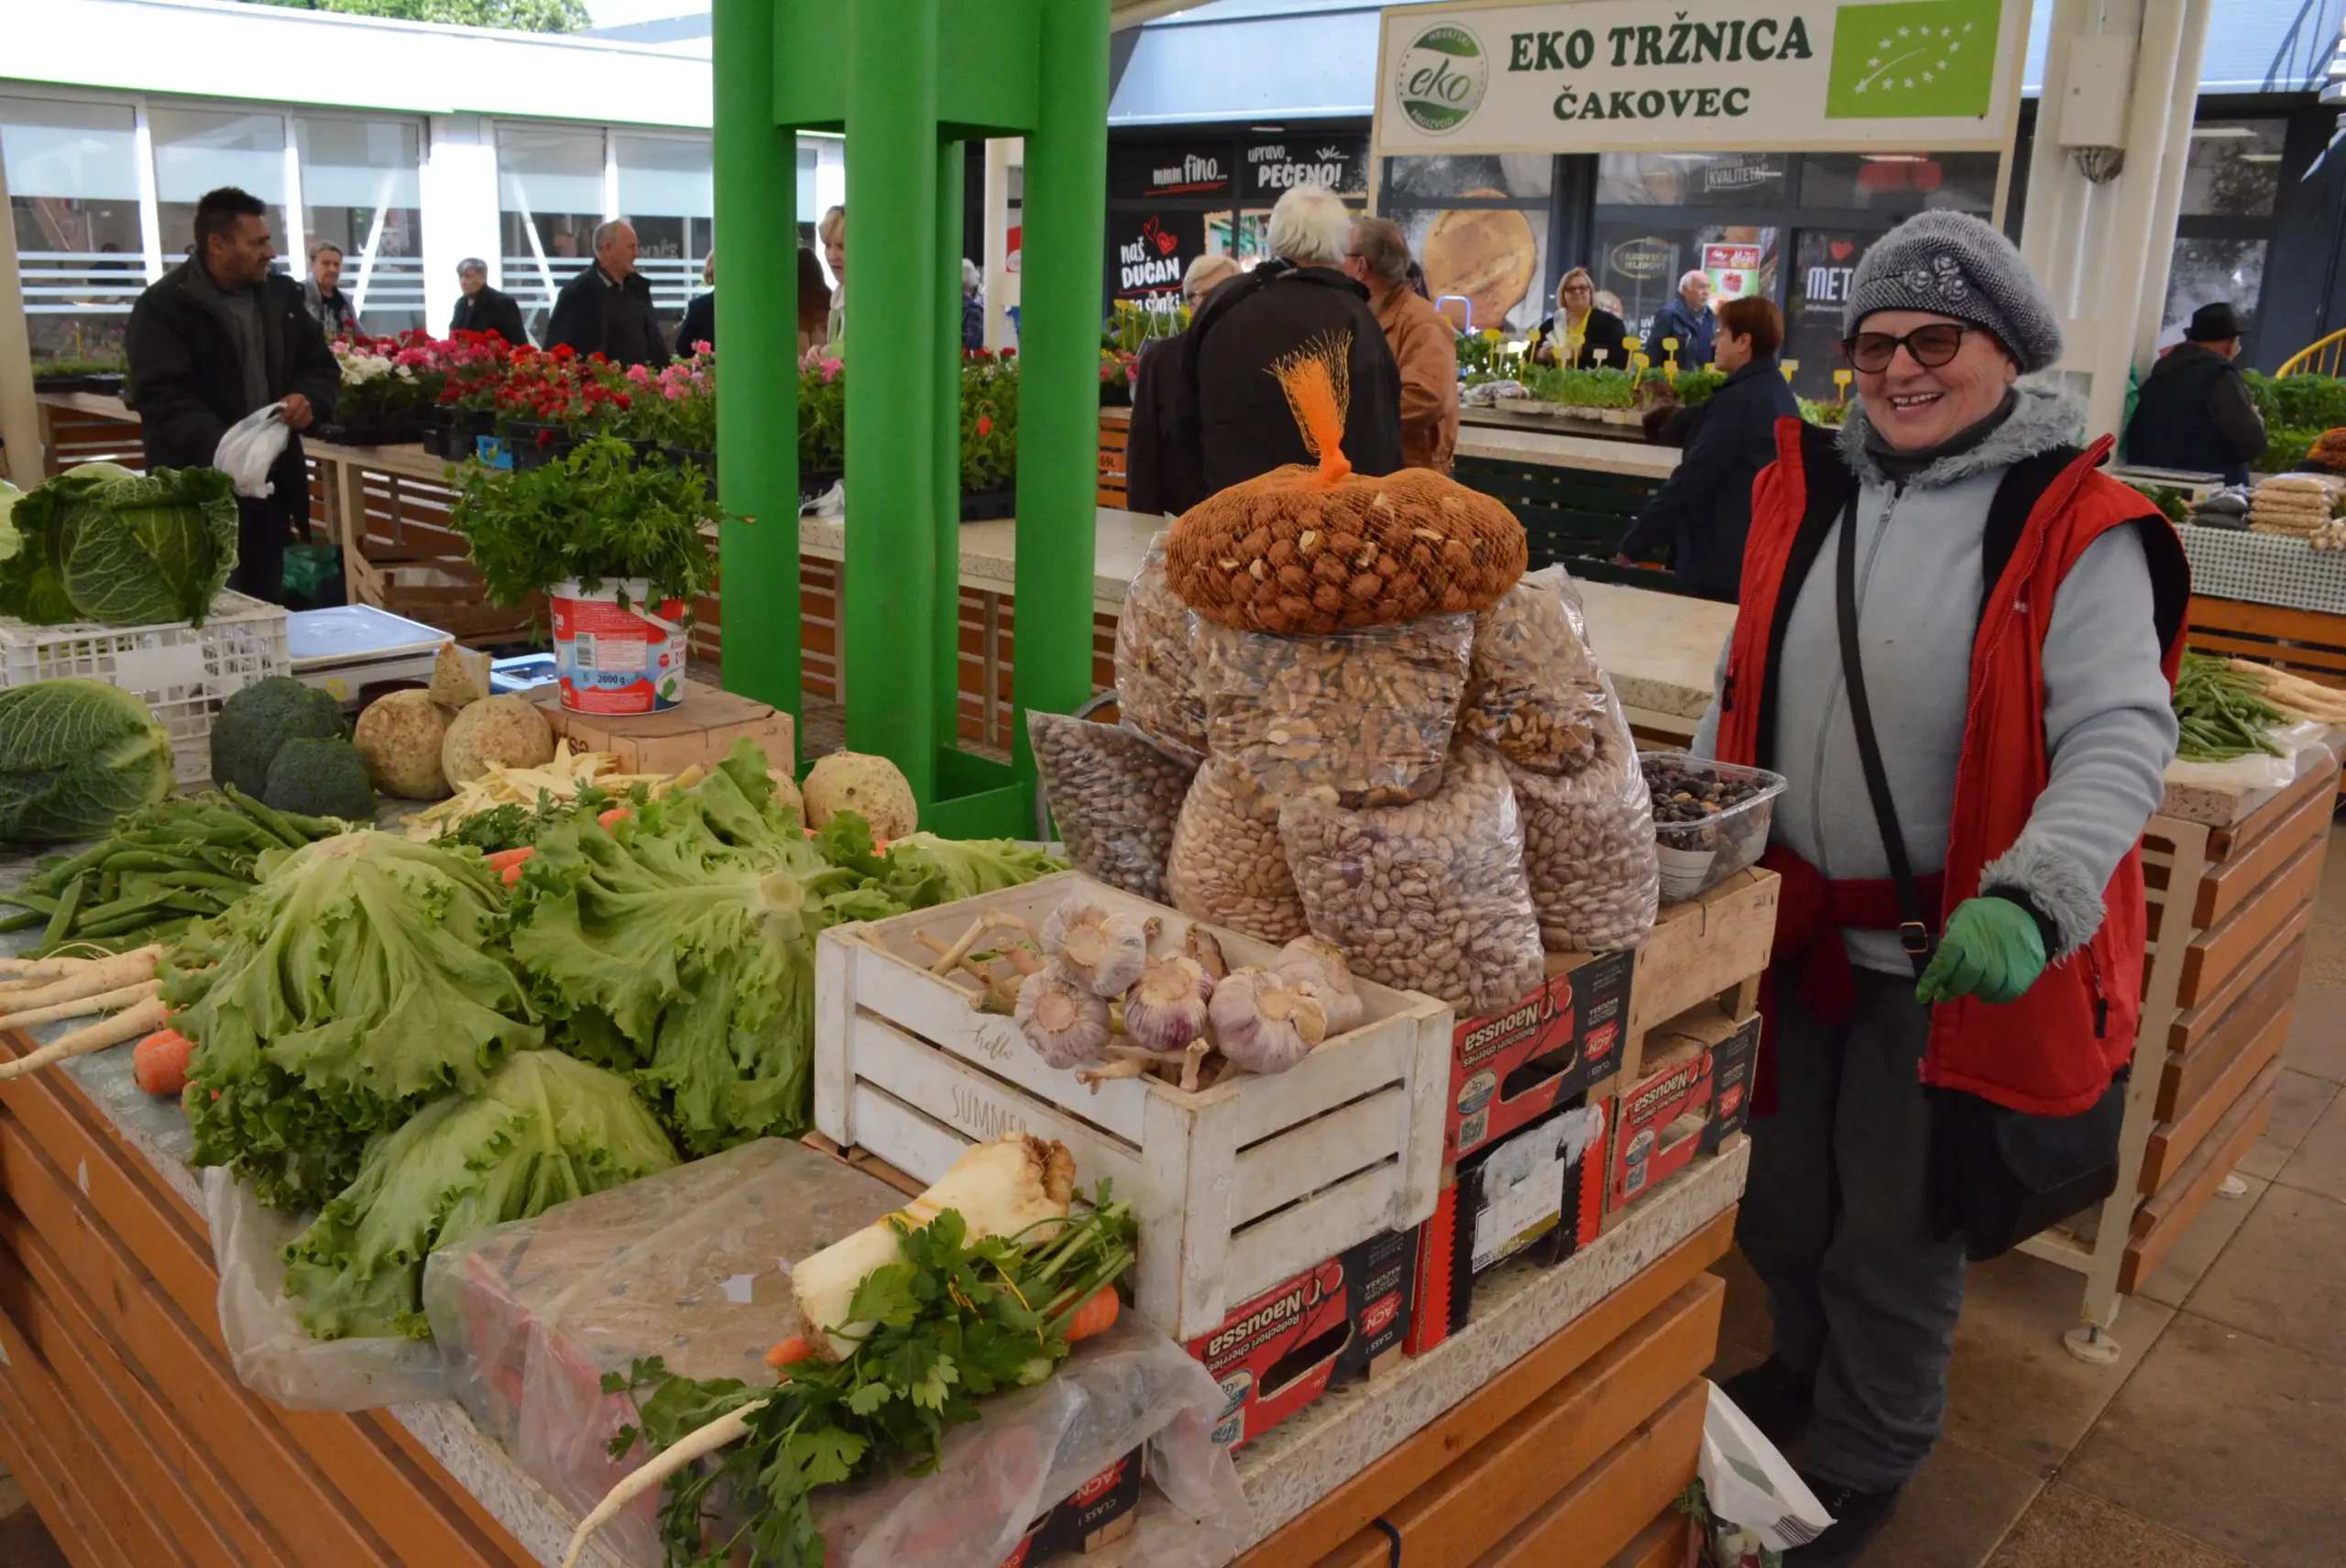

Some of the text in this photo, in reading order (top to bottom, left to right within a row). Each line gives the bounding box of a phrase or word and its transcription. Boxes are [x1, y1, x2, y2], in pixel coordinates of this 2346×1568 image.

[1507, 11, 1814, 71] EKO TRŽNICA
[1409, 57, 1471, 103] eko
[1410, 107, 1453, 128] PROIZVOD
[1552, 84, 1750, 121] ČAKOVEC
[1153, 153, 1228, 185] mmm fino...
[1247, 145, 1286, 163] upravo
[1257, 157, 1343, 189] PEČENO!
[1121, 236, 1145, 264] naš
[1121, 256, 1180, 289] DUĆAN
[1806, 267, 1854, 301] MET
[597, 674, 619, 684] 2000
[619, 677, 626, 685] g
[968, 1023, 1015, 1061] hello
[1464, 1002, 1539, 1052] Naoussa
[1463, 1045, 1496, 1068] cherries
[1588, 1032, 1613, 1056] ACN
[1591, 1059, 1611, 1077] CLASS
[1634, 1070, 1688, 1113] Naoussa
[1365, 1265, 1402, 1291] NAOUSSA
[1209, 1289, 1301, 1357] Naoussa
[1365, 1304, 1394, 1332] ACN
[1208, 1314, 1299, 1373] Rodochori cherries
[1370, 1331, 1394, 1352] CLASS
[1076, 1468, 1115, 1501] ACN
[1085, 1498, 1117, 1523] CLASS
